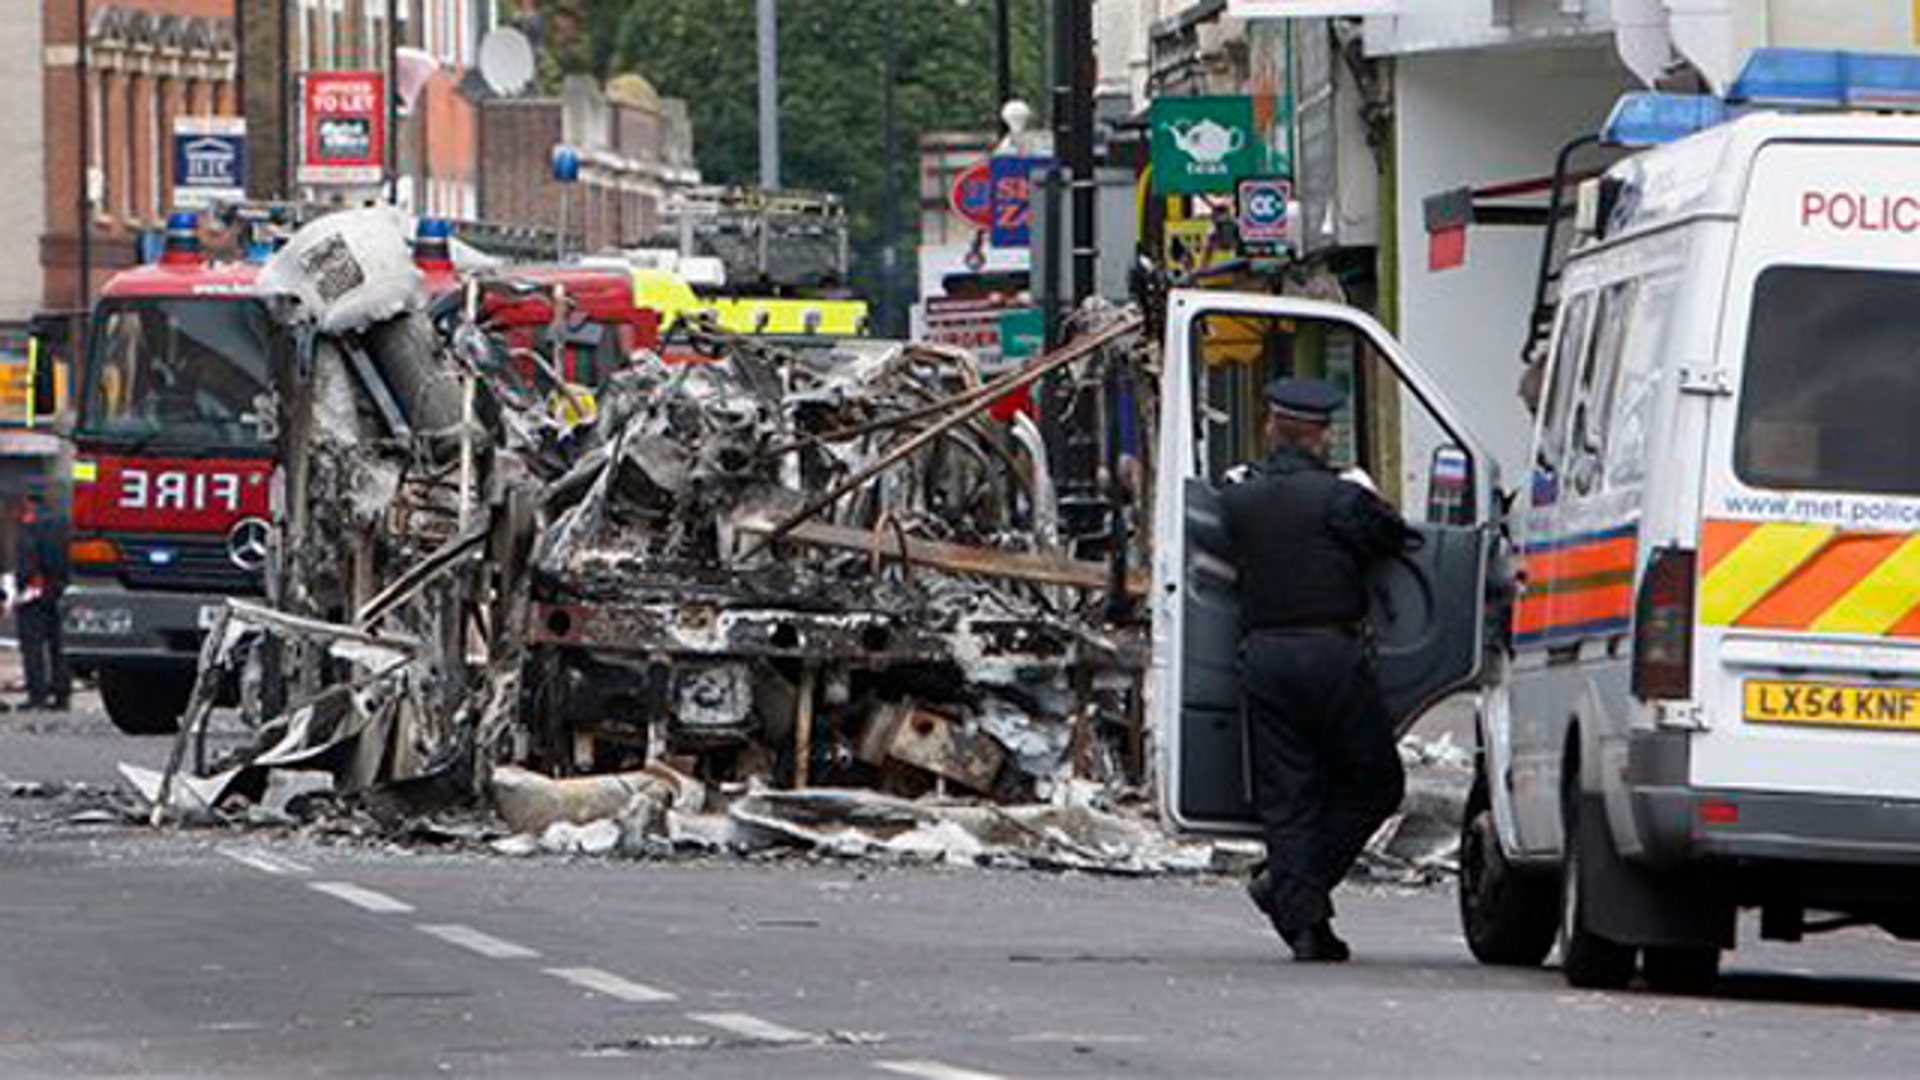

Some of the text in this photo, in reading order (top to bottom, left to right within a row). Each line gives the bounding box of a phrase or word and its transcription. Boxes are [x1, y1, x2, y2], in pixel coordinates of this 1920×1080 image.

[311, 95, 375, 112] TO LET
[1801, 192, 1920, 232] POLIC
[1759, 687, 1912, 721] LX54 KNF
